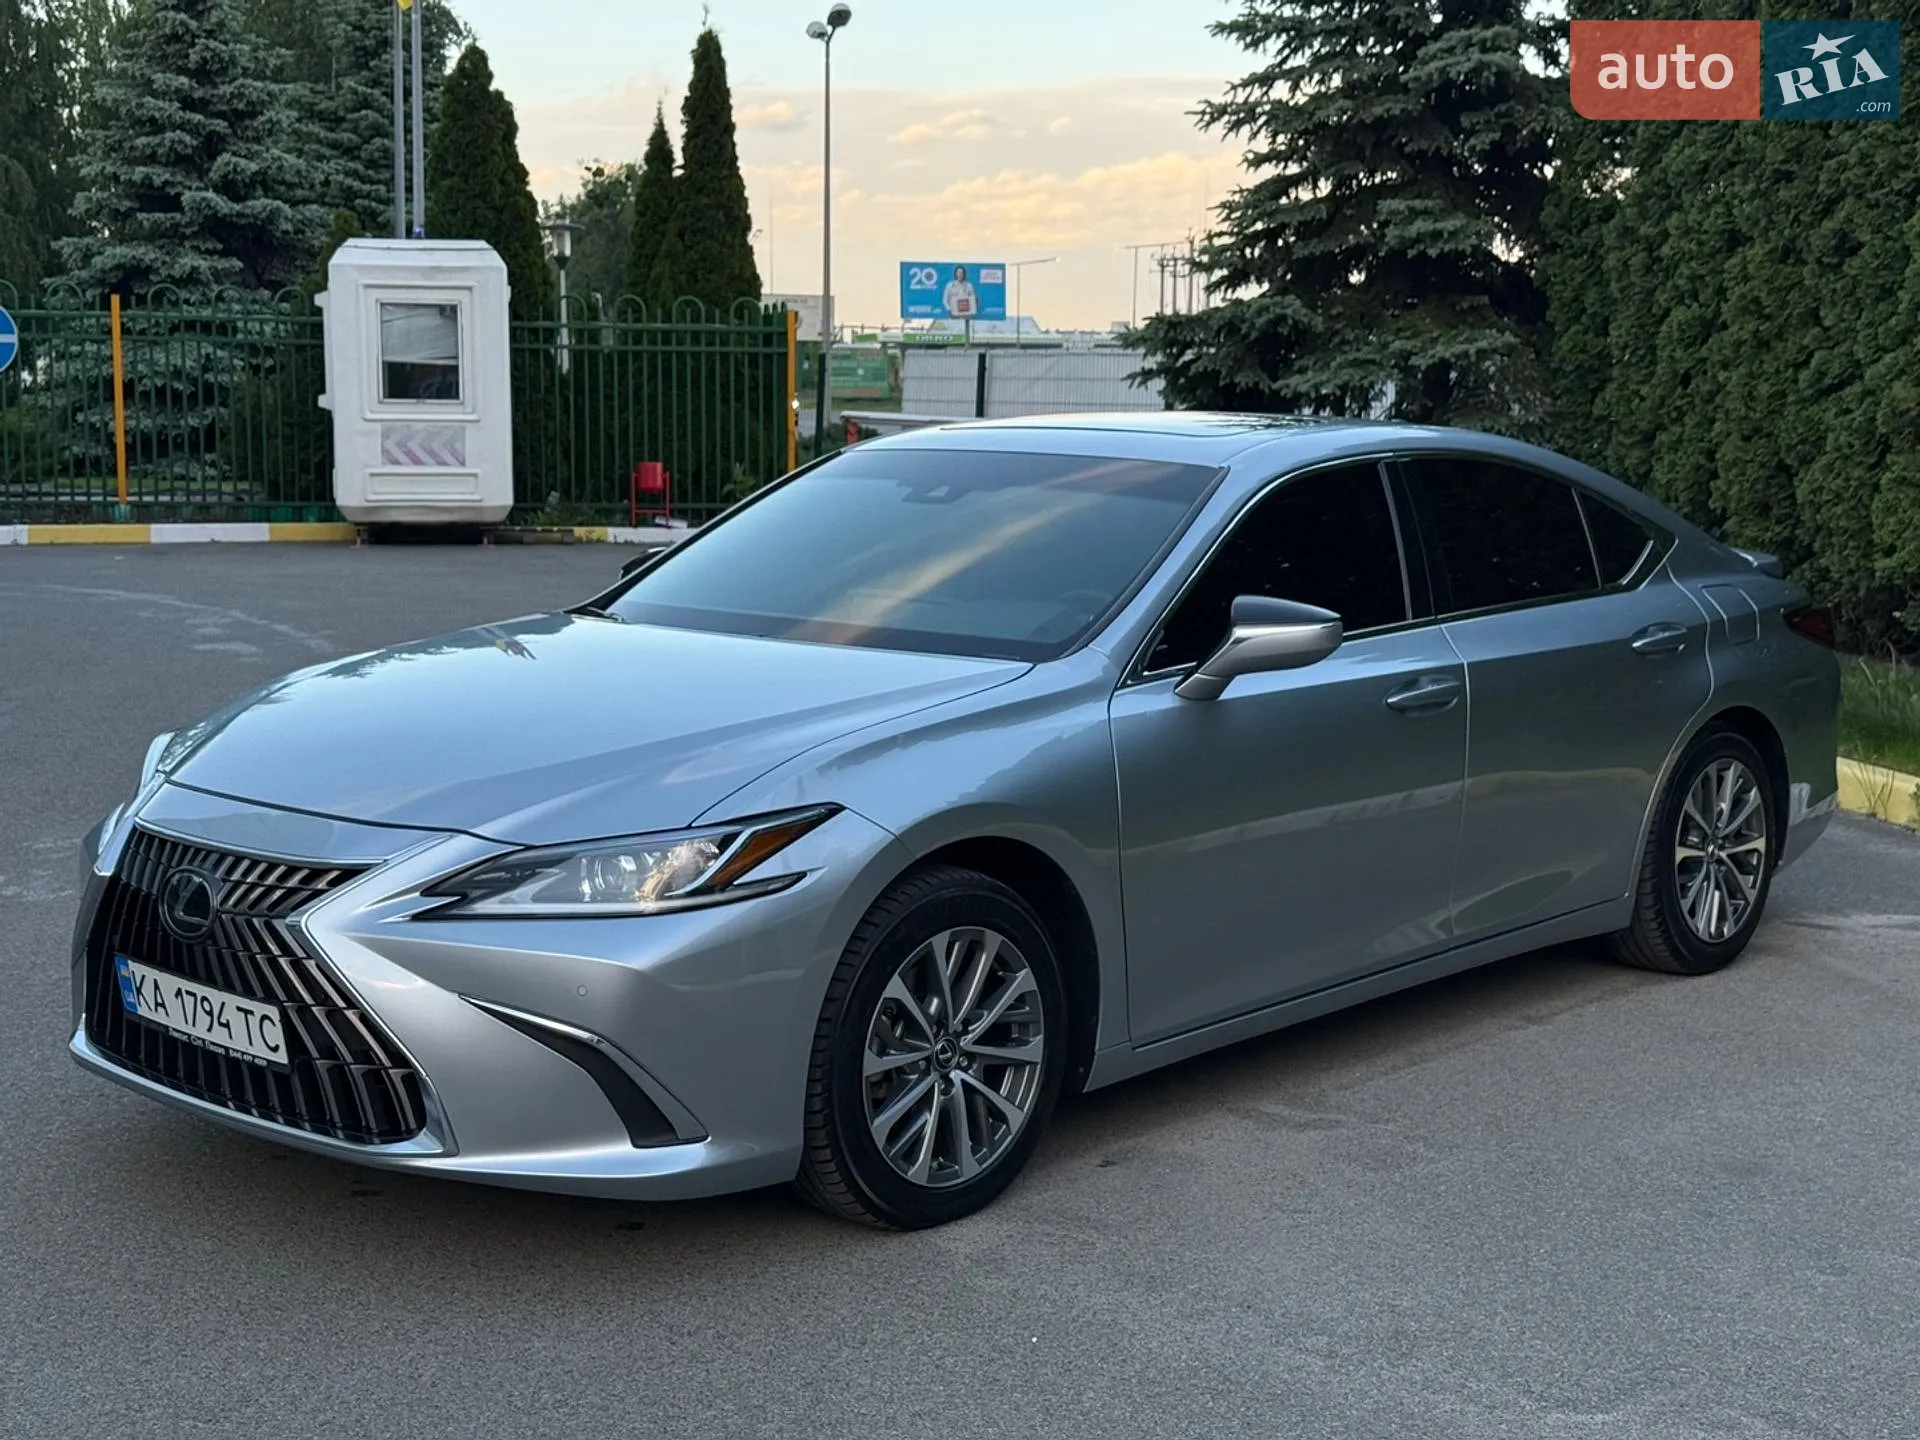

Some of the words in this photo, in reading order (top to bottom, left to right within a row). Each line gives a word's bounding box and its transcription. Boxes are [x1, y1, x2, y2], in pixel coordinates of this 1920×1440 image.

[909, 267, 938, 286] 20
[131, 970, 169, 1017] KA
[174, 987, 233, 1040] 1794
[236, 1004, 280, 1054] TC
